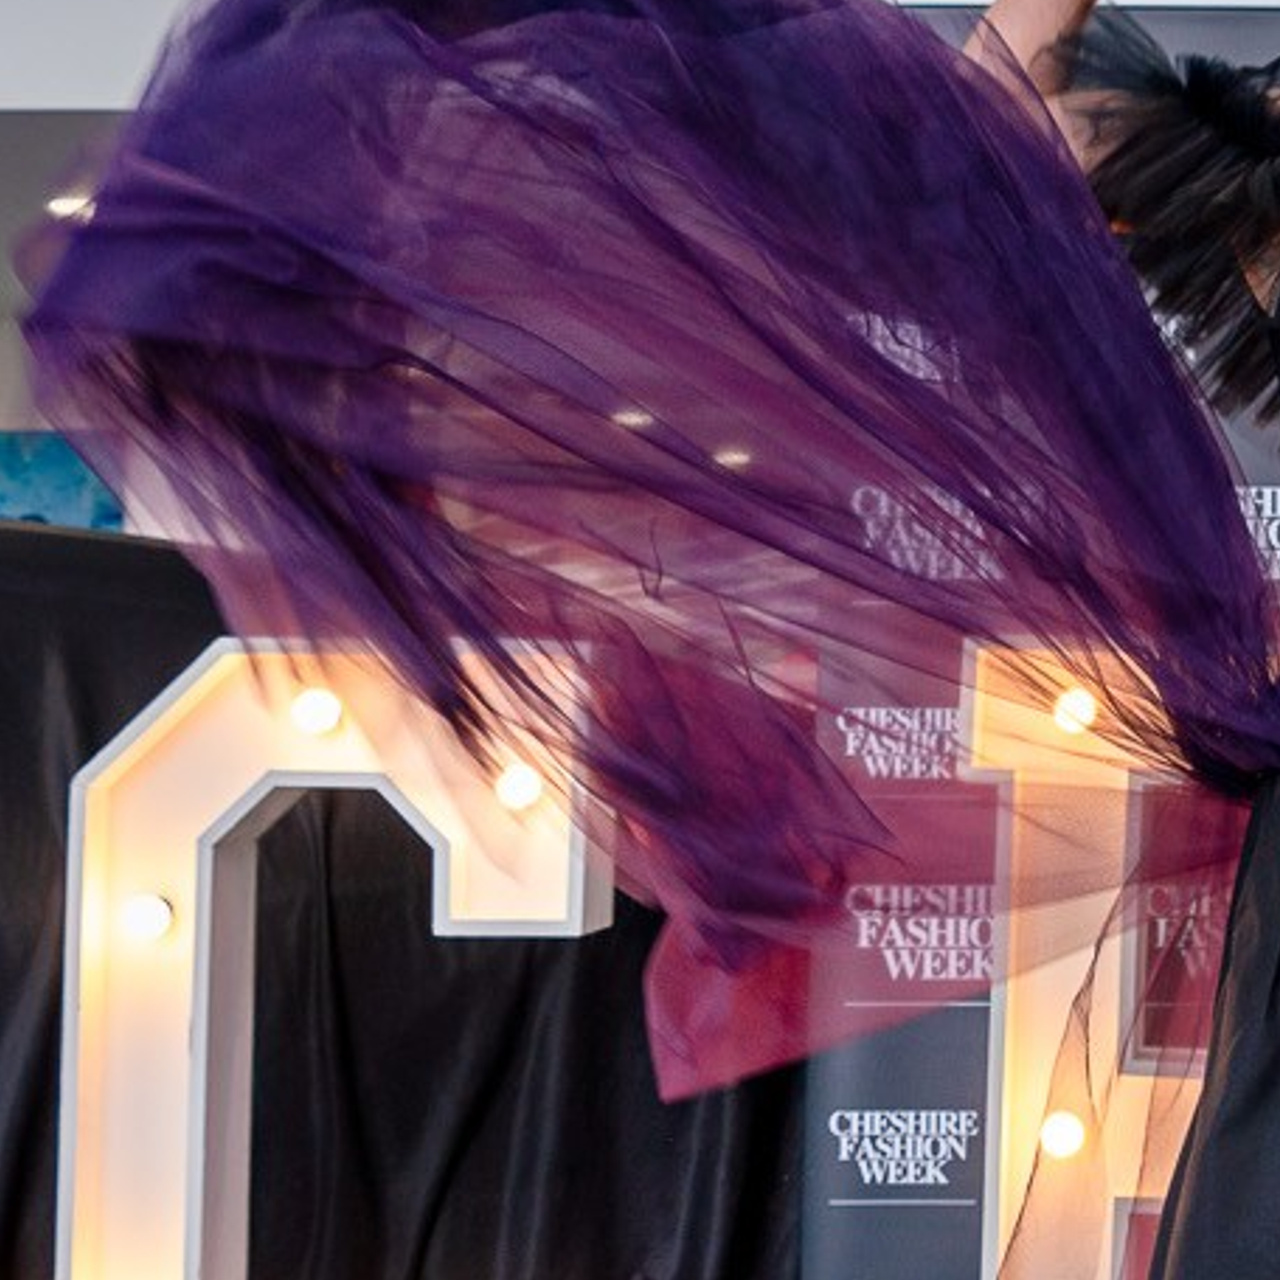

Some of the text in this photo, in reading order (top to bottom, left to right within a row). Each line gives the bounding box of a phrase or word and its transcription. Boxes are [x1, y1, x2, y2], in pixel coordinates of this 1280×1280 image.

[863, 755, 951, 779] WEEK
[845, 884, 992, 917] CHESHI
[856, 917, 994, 948] FASHIO
[828, 1110, 980, 1137] CHESHIRE
[838, 1136, 967, 1161] FASHION
[857, 1160, 949, 1184] WEEK
